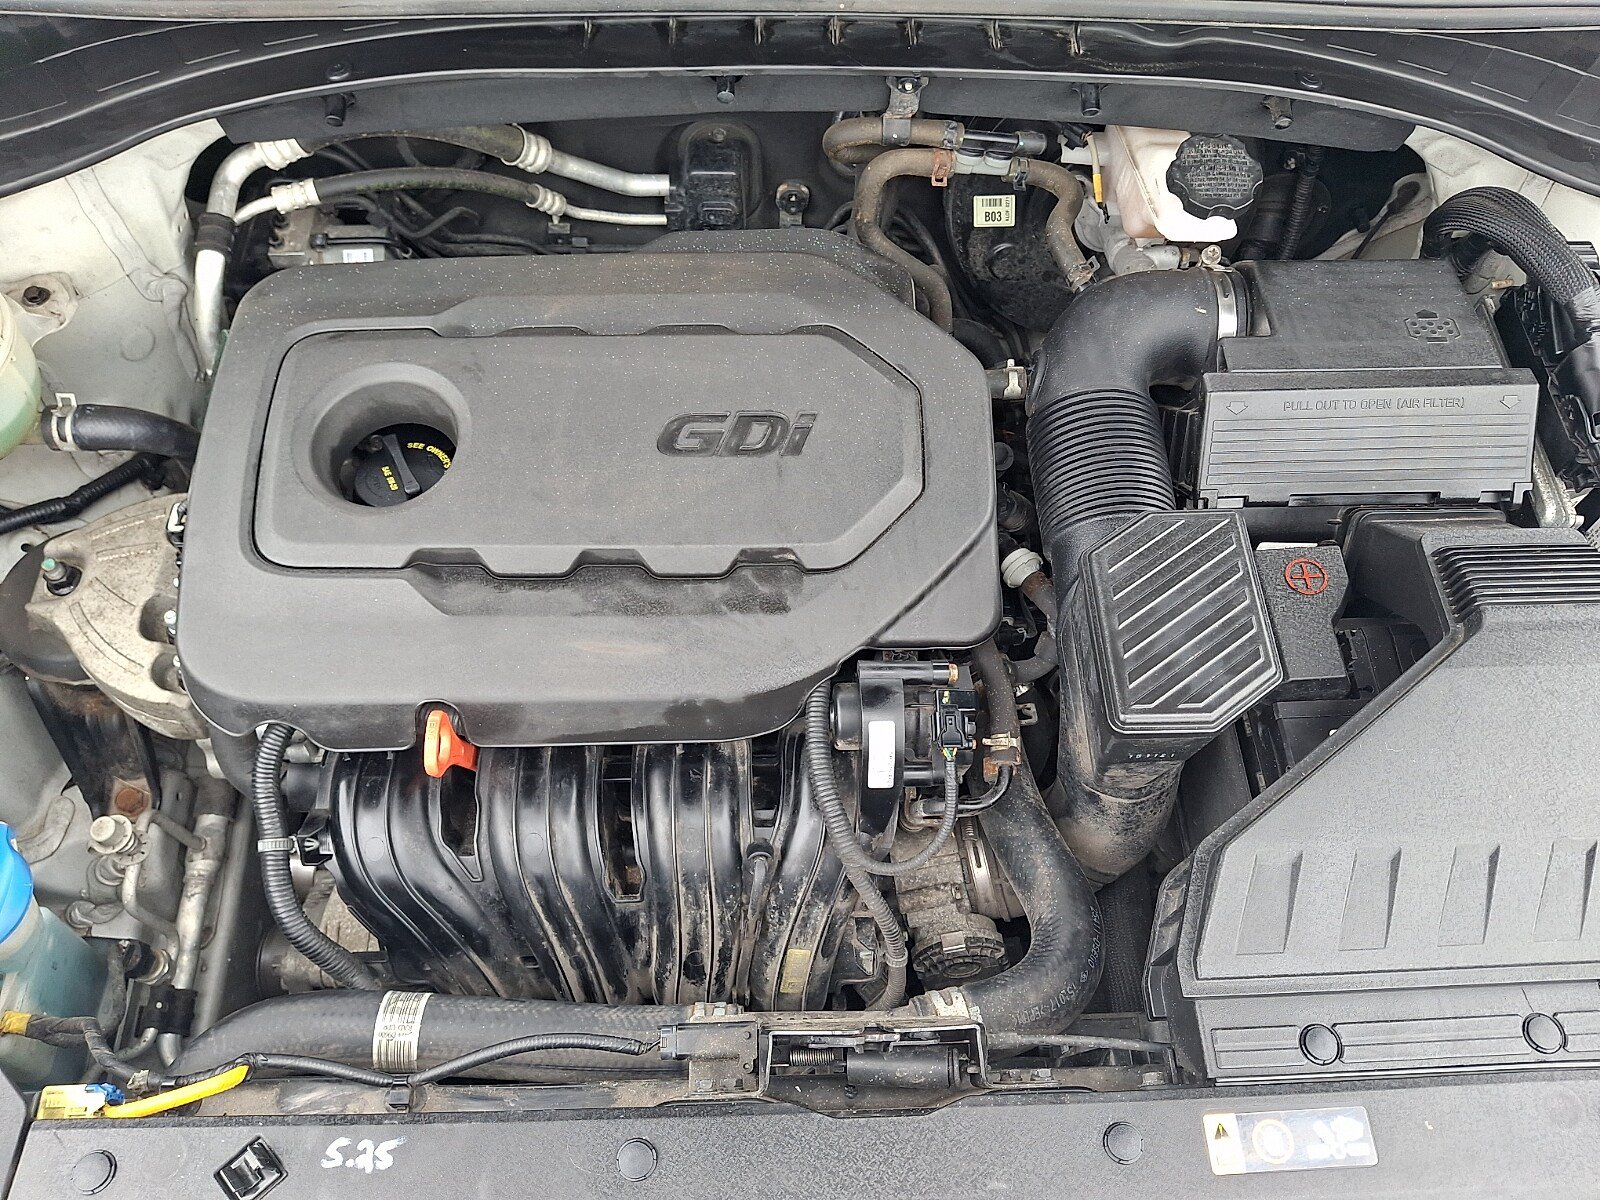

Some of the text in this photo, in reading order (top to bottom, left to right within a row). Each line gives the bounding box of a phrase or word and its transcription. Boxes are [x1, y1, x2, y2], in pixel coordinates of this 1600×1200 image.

[984, 211, 1002, 222] B03
[1283, 397, 1466, 412] PULL OUT TO OPEN (AIR FILTER)
[656, 410, 819, 457] GDi
[407, 442, 426, 450] SEE
